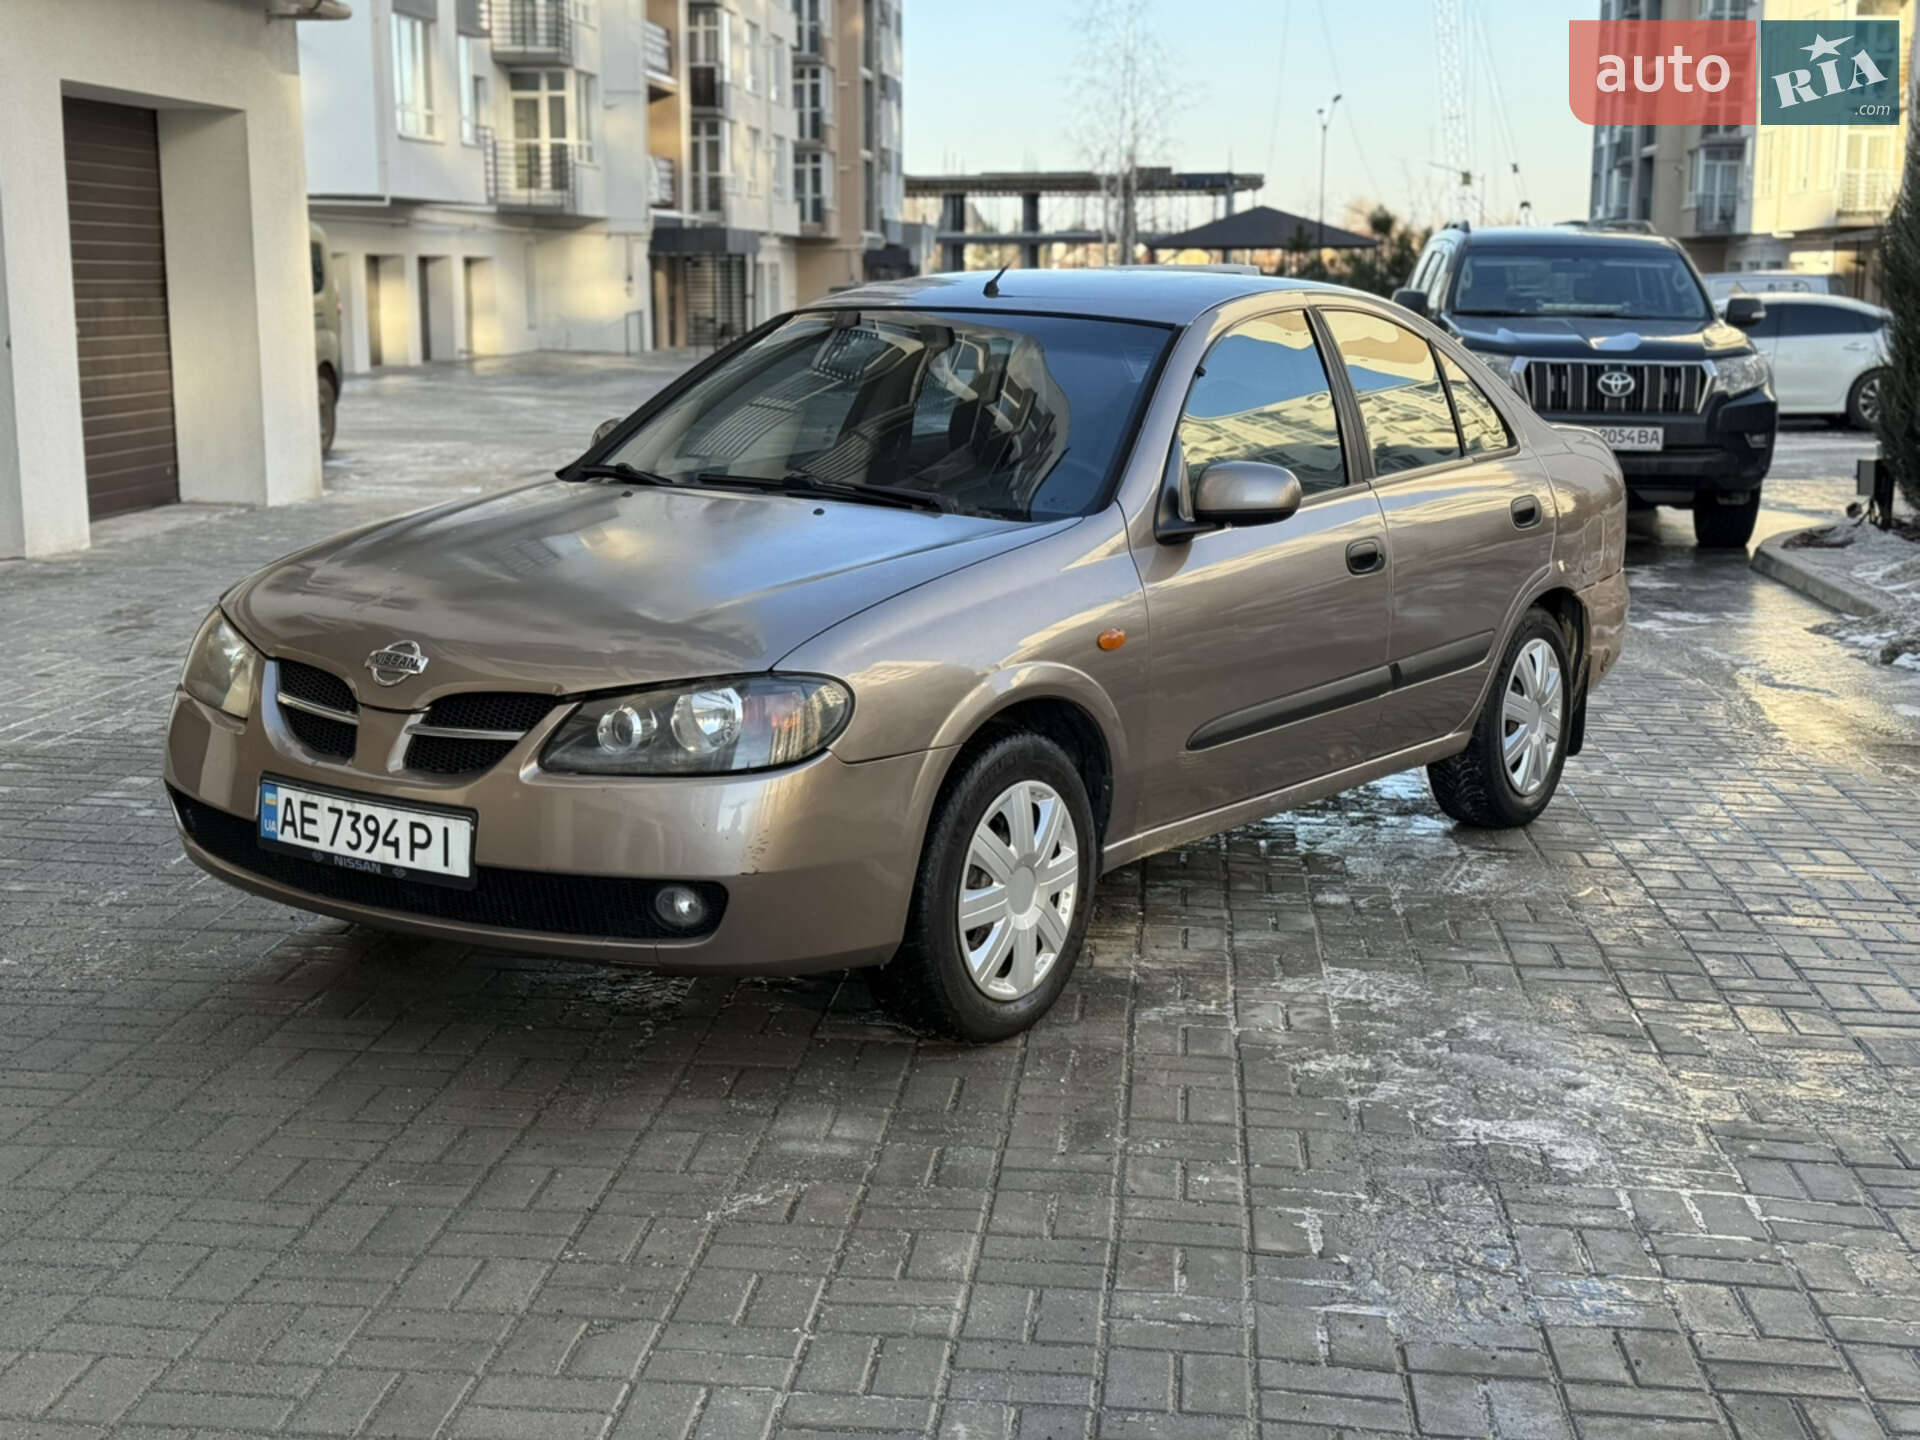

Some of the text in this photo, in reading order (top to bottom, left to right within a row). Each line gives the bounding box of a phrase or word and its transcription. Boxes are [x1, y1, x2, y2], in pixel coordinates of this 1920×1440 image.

[374, 653, 419, 668] NISSAN
[264, 818, 277, 833] UA
[334, 855, 381, 874] NISSAN
